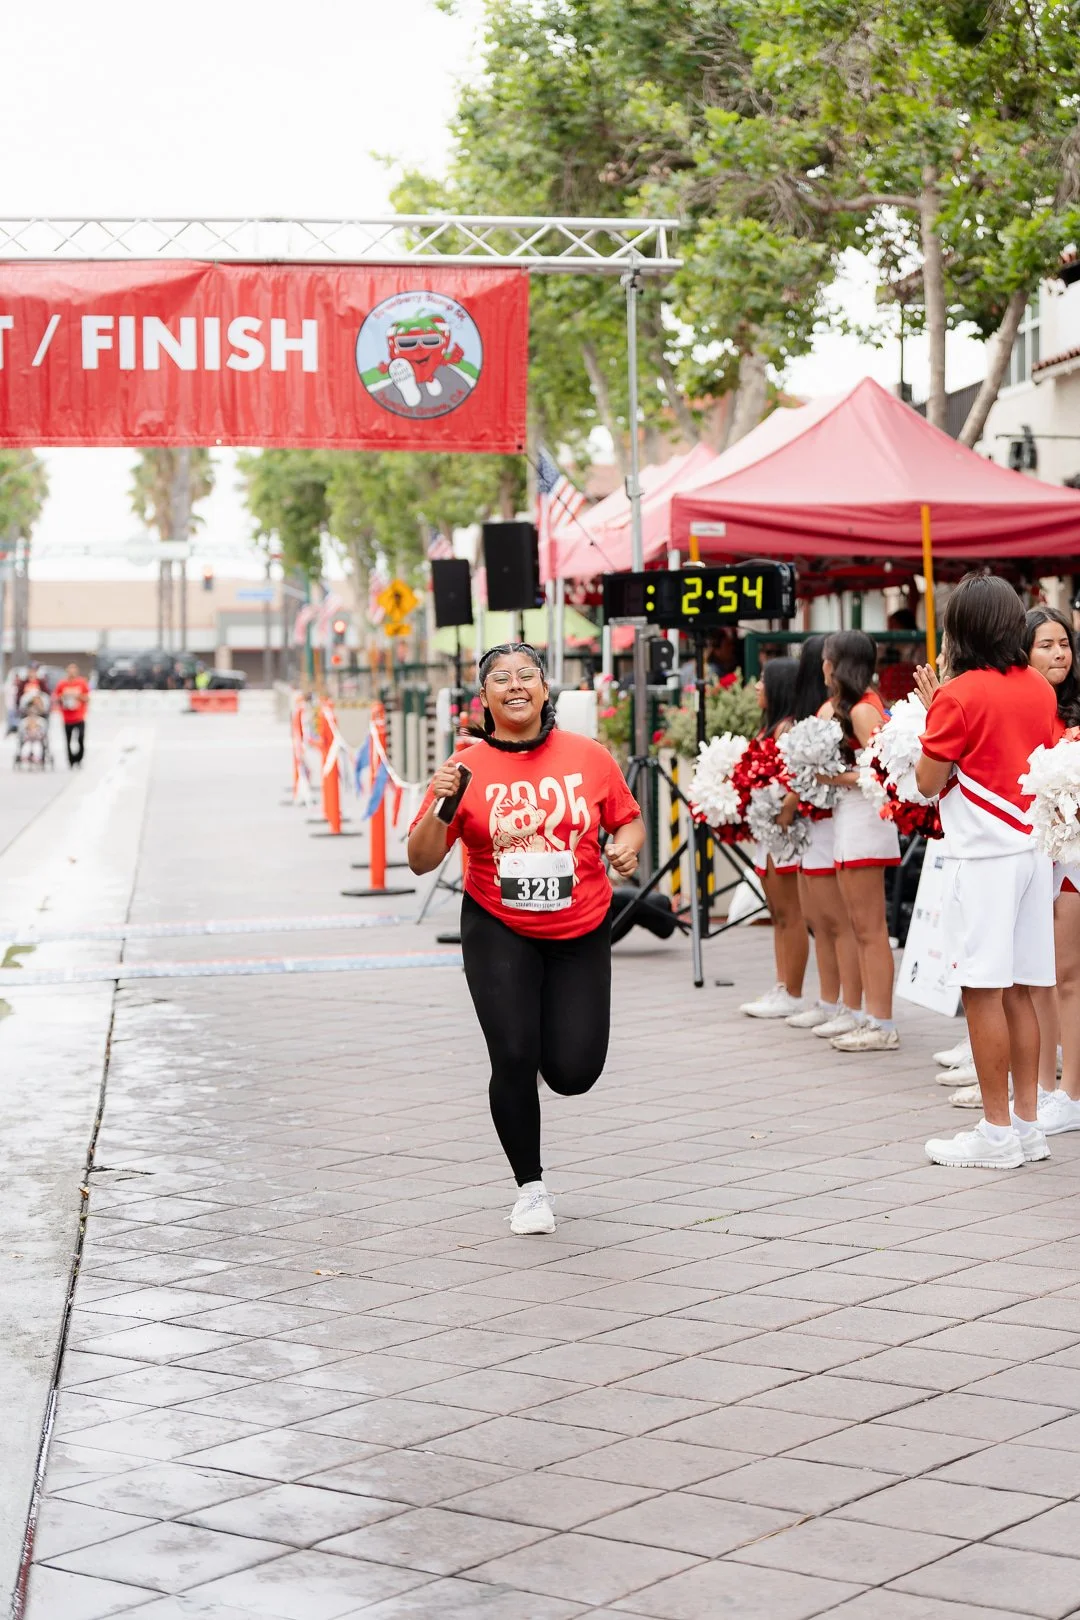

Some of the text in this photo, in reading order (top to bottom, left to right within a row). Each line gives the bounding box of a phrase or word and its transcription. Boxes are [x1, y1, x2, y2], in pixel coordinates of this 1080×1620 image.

[81, 315, 319, 373] FINISH
[485, 772, 591, 851] 2025
[517, 878, 560, 901] 328
